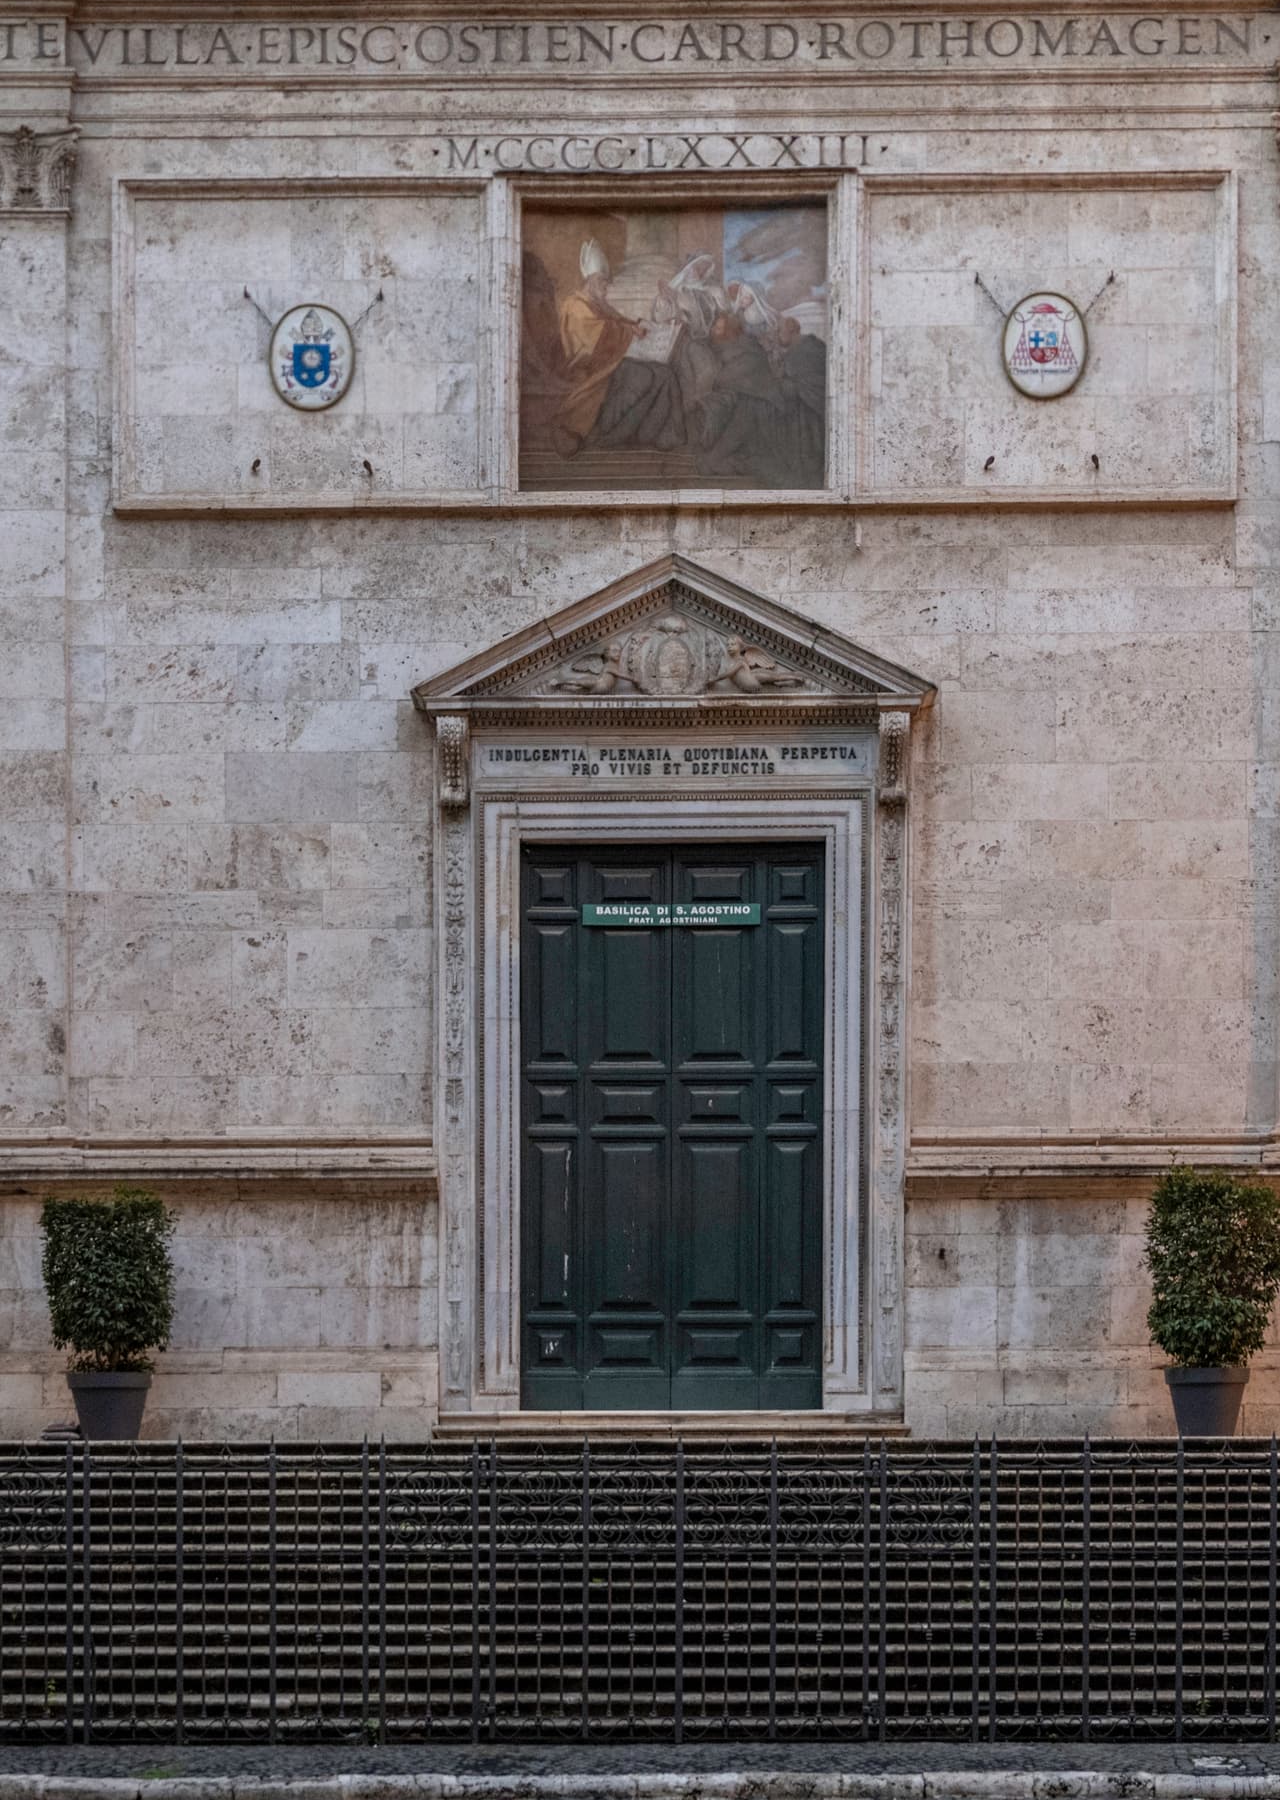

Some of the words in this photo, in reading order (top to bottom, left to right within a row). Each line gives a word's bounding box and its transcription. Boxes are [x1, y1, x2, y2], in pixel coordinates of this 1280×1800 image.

[257, 25, 397, 65] EPISC
[630, 22, 801, 63] CARD
[489, 749, 587, 762] INDULGENTIA
[600, 749, 672, 761] PLENARIA
[684, 748, 769, 762] QUOTIDIANA
[781, 747, 857, 760] PERPETUA
[572, 763, 600, 776] PRO
[610, 763, 651, 775] VIVIS
[663, 763, 681, 775] ET
[692, 762, 775, 775] DEFUNCTIS
[596, 906, 650, 915] BASILICA
[657, 906, 668, 915] DI
[676, 906, 687, 915] S.
[690, 905, 751, 915] AGOSTINO
